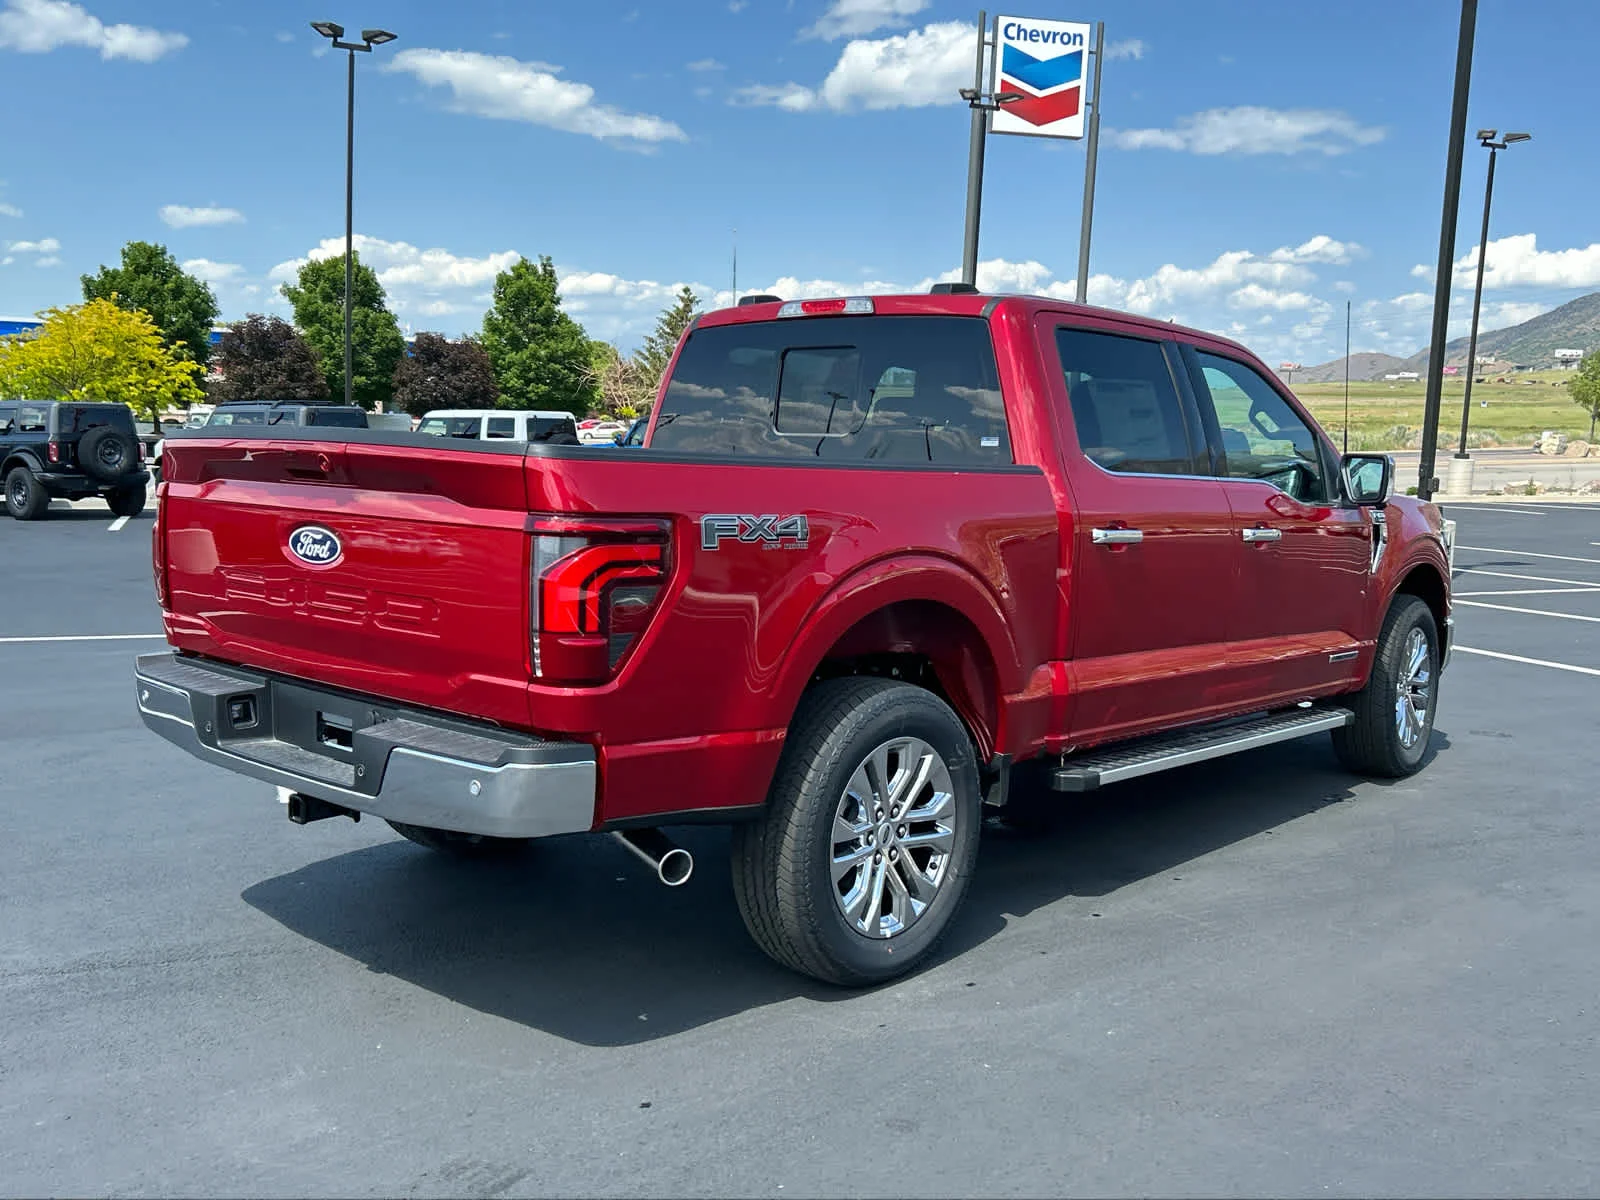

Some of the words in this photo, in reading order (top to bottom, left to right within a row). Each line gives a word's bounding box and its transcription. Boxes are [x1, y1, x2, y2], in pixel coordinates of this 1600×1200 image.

[1003, 22, 1084, 47] Chevron
[296, 531, 331, 559] Ford
[701, 514, 809, 551] FX4
